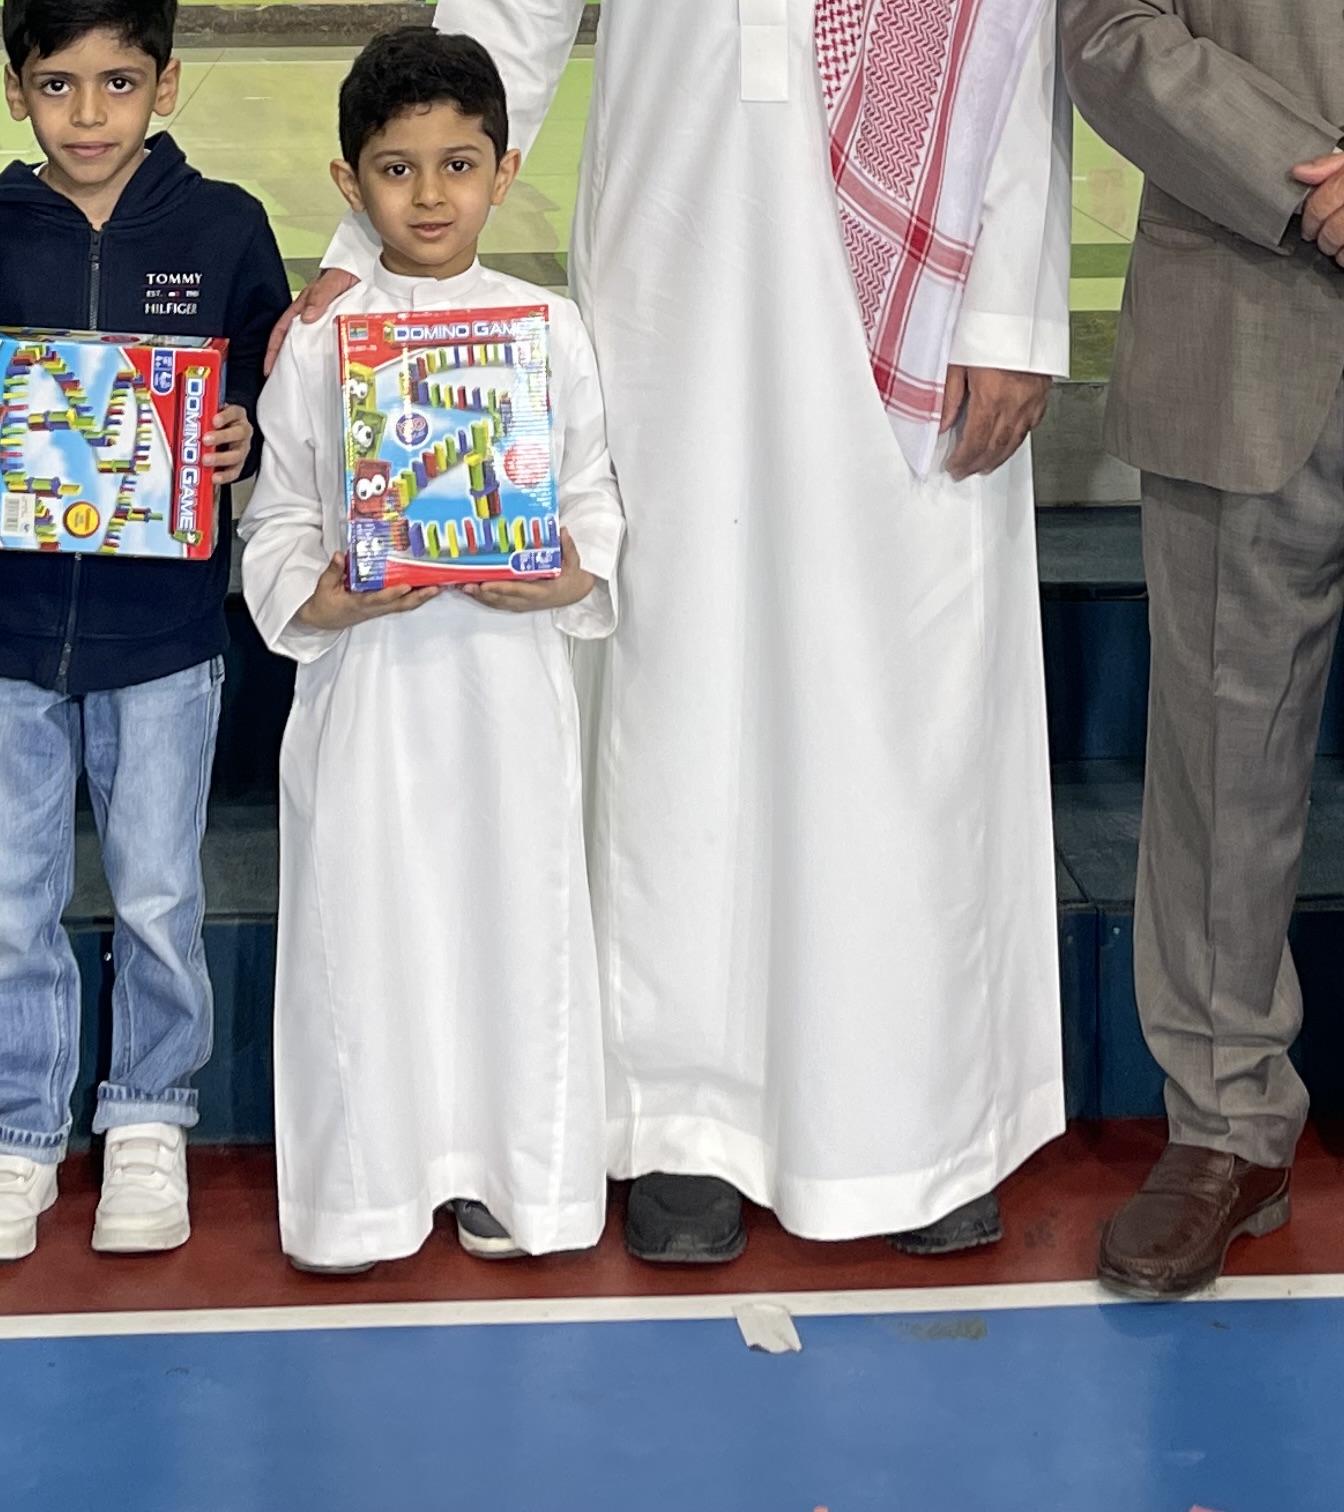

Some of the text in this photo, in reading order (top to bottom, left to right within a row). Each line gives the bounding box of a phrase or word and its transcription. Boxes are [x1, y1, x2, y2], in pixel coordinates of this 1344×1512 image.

[146, 272, 203, 285] TOMMY
[144, 302, 197, 315] HILFIGER
[394, 318, 524, 341] DOMINO GAM
[179, 377, 204, 531] DOMINO GAME
